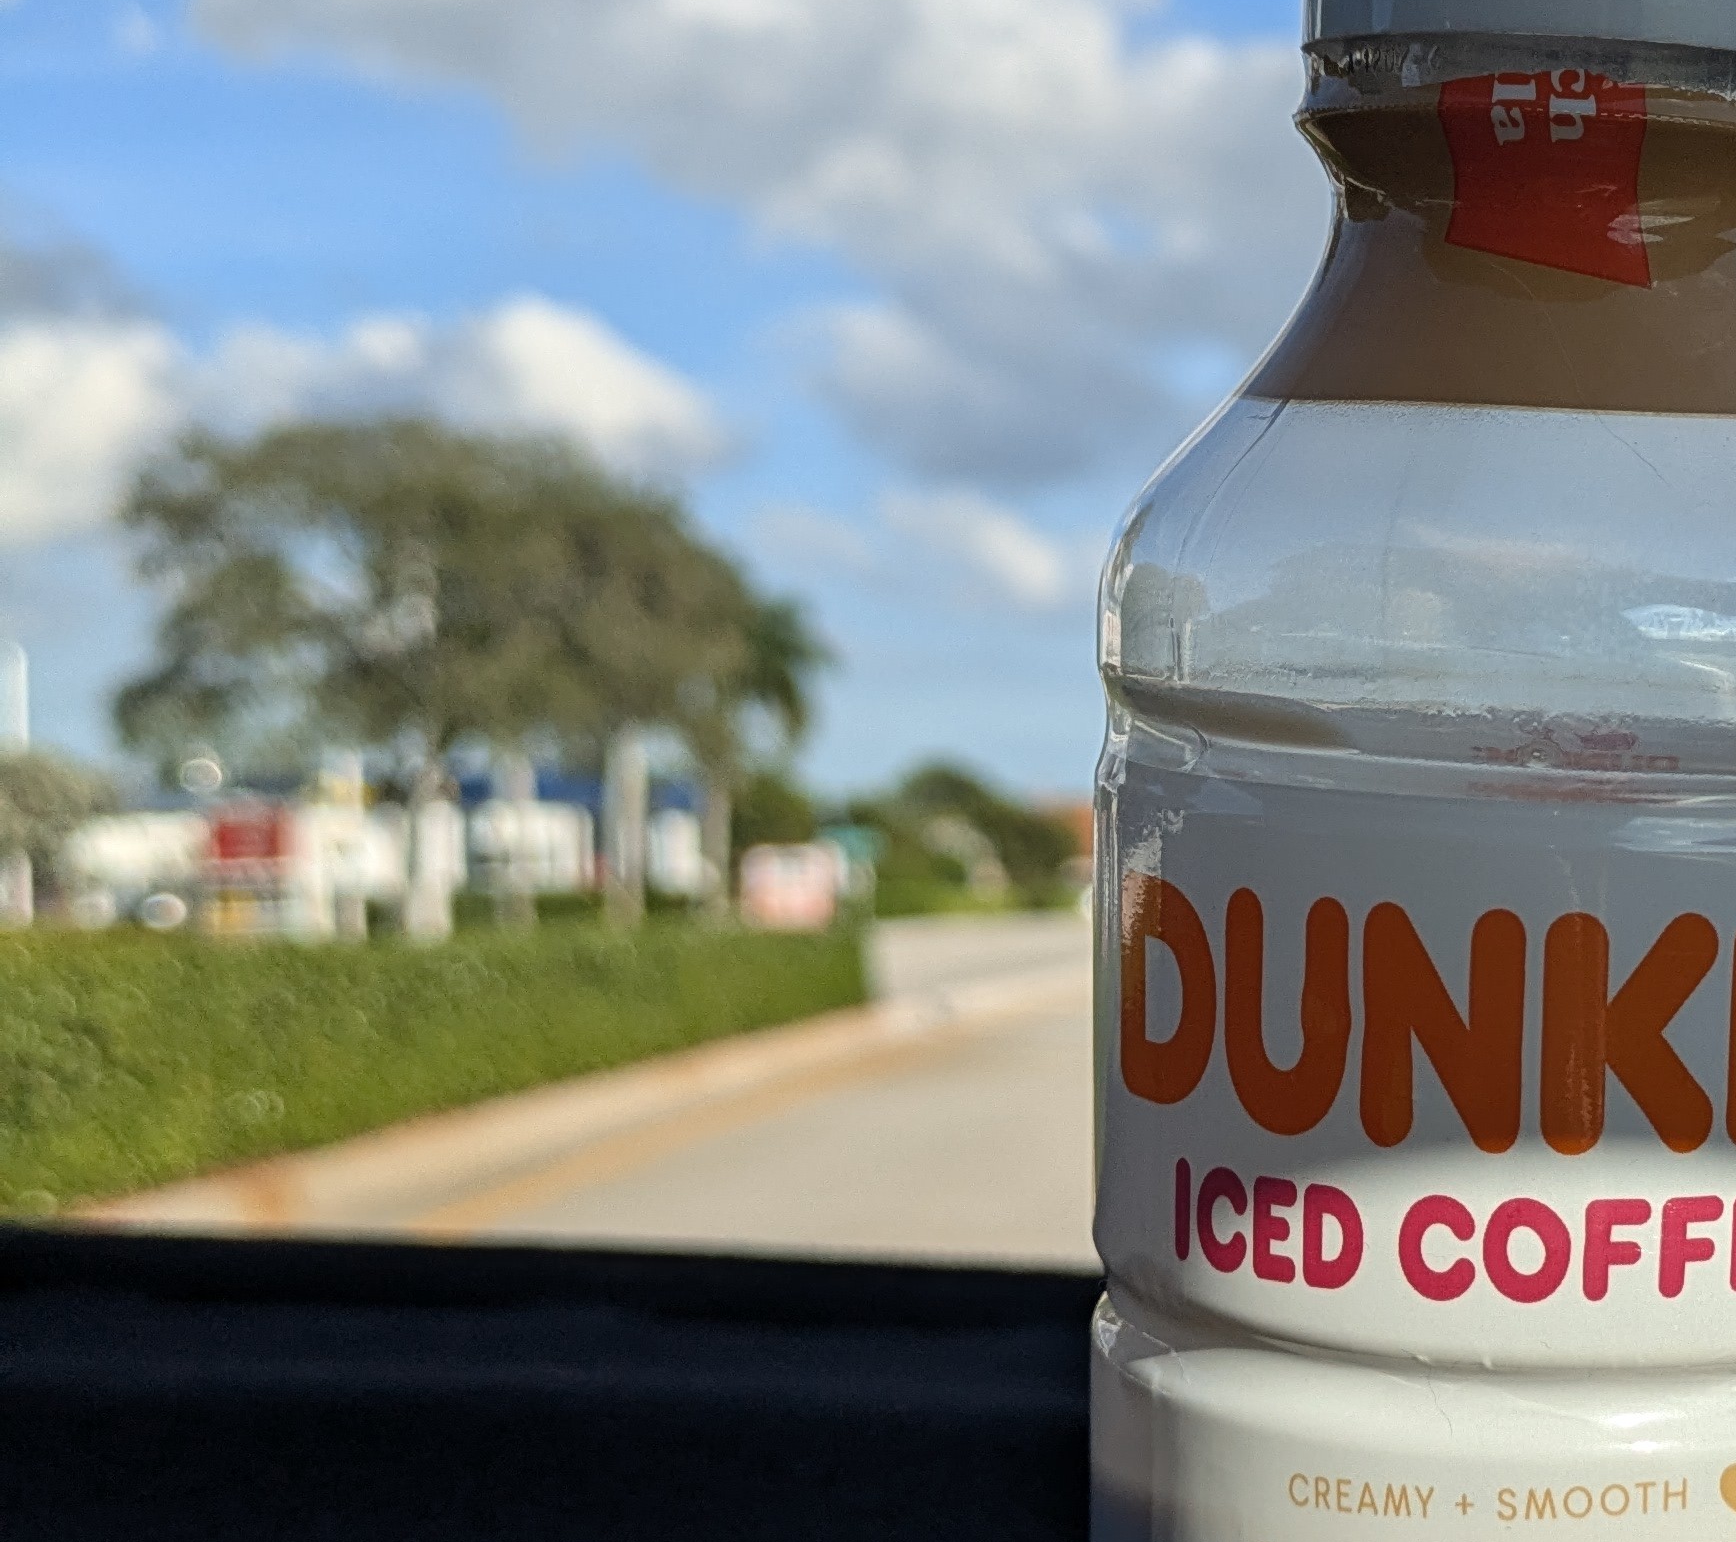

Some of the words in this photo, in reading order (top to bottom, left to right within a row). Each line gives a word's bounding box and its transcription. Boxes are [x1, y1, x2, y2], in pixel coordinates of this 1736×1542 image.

[1175, 1156, 1364, 1289] ICED
[1287, 1471, 1436, 1520] CREAMY
[1454, 1494, 1475, 1516] +
[1496, 1477, 1690, 1522] SMOOTH
